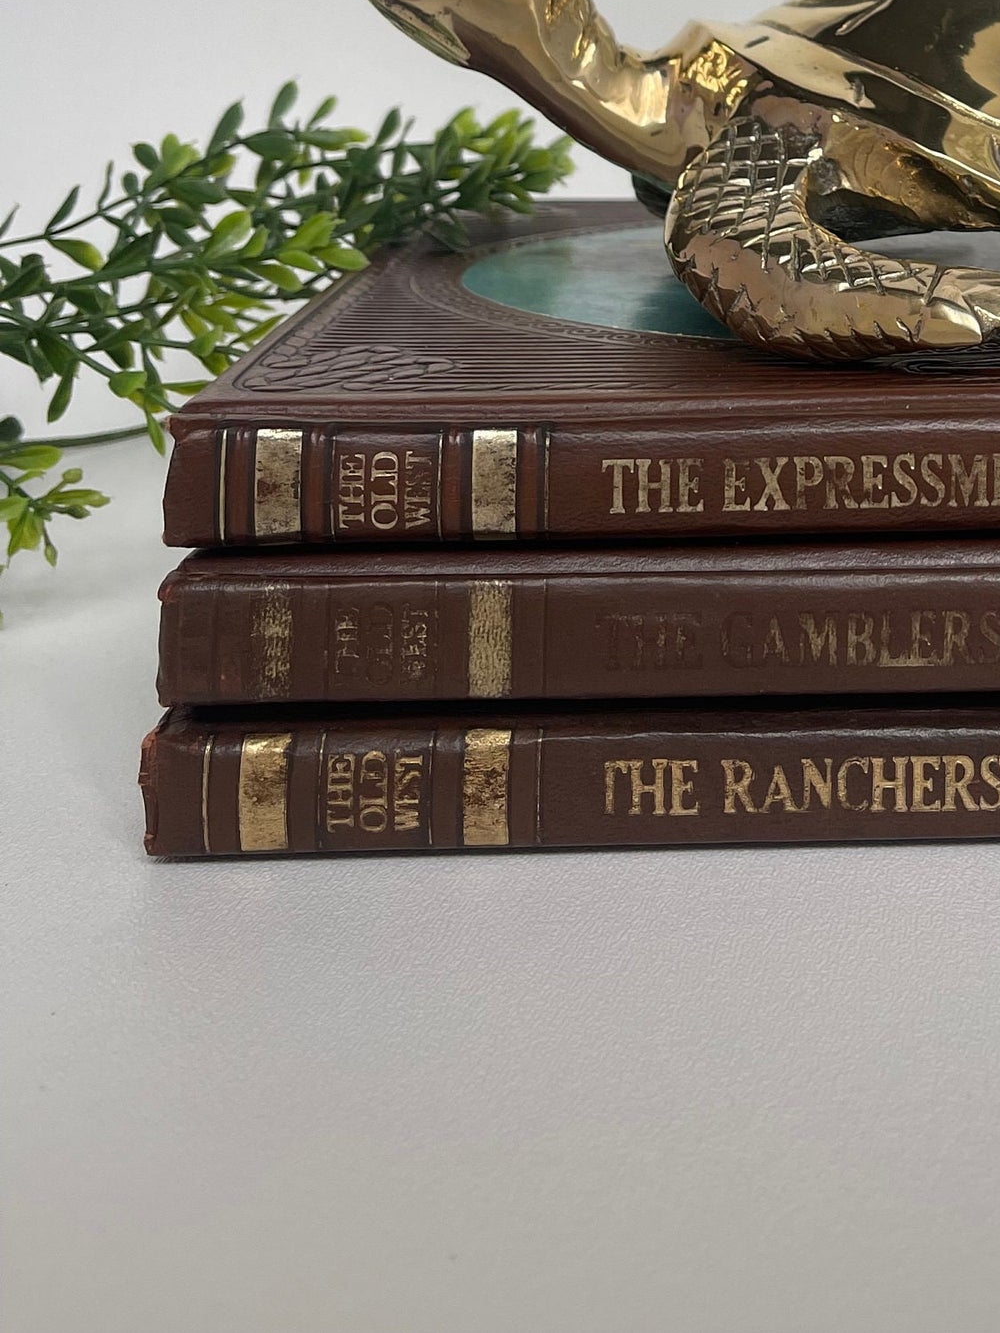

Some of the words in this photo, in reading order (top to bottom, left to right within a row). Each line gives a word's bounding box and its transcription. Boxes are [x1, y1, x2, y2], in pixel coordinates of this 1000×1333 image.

[339, 453, 366, 529] THE
[371, 451, 399, 530] OLD
[404, 450, 432, 530] WEST
[601, 458, 704, 514] THE
[327, 754, 356, 834] THE
[359, 750, 388, 833] OLD
[394, 750, 423, 831] WEST
[604, 758, 699, 816] THE
